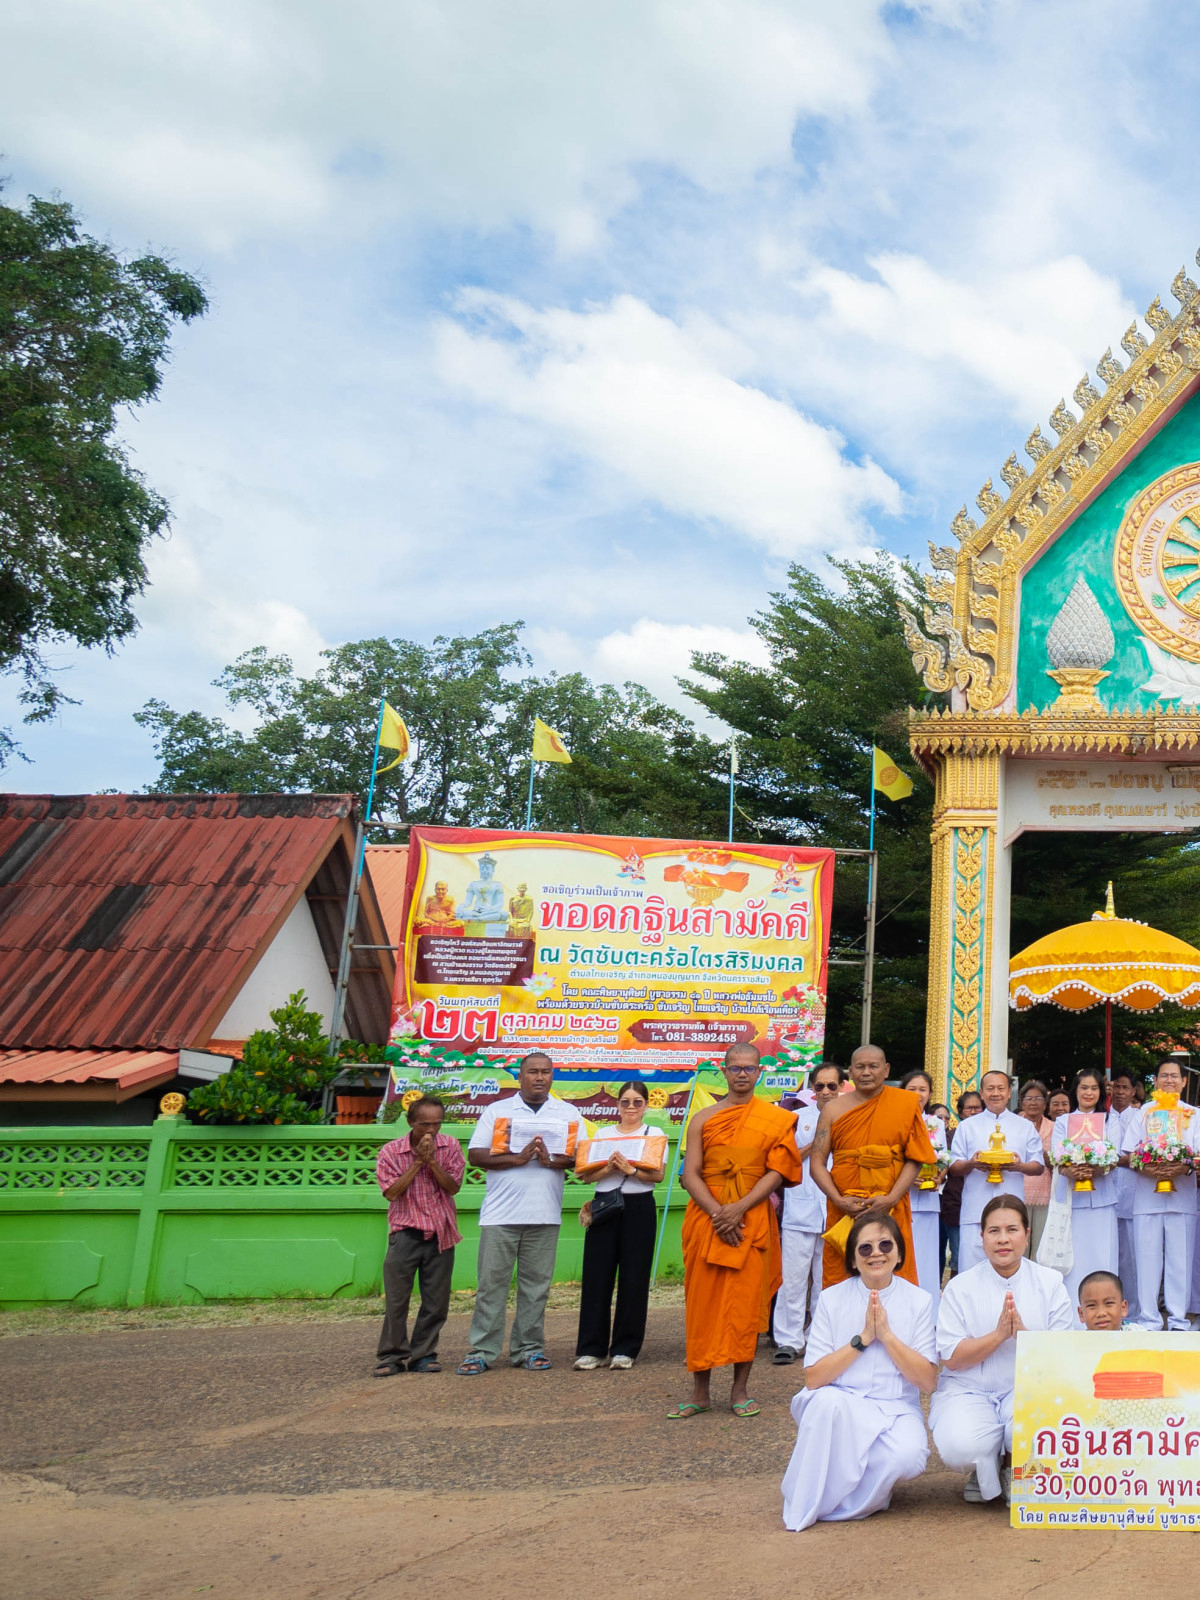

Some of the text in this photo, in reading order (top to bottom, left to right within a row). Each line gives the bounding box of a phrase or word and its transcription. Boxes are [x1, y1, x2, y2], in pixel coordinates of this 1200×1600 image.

[1137, 518, 1165, 577] สำนักงาน
[542, 885, 644, 898] ขอเชิญร่วมเป็นเจ้าภาพ
[540, 895, 808, 943] ทอดกฐินสามัคคี
[540, 943, 804, 972] ณ วัดซับตะคร้อไตรสิริมงคล
[570, 968, 770, 984] ตำบลไทยเจริญ อำเภอหนองบุญมาก จังหวัดนครราชสีมา
[439, 994, 500, 1007] วันพฤหัสบดีที่
[562, 984, 578, 996] โดย
[581, 986, 647, 1000] คณะศิษยานุศิษย์
[649, 989, 686, 1001] บูชาธรรม
[703, 989, 711, 999] ปี
[713, 990, 777, 1002] หลวงพ่อธัมมชโย
[693, 1000, 729, 1015] ไทยเจริญ
[731, 1001, 798, 1015] บ้านใกล้เรือนเคียง
[422, 1000, 497, 1040] ๒๓
[502, 1013, 617, 1032] ตุลาคม ๒๕๖๘
[666, 1032, 737, 1042] 081-3892458
[470, 1079, 498, 1097] ทุกคืน
[1034, 1470, 1148, 1499] 30,000วัด
[1019, 1506, 1043, 1523] โดย
[1048, 1508, 1156, 1528] คณะศิษยานุศิษย์
